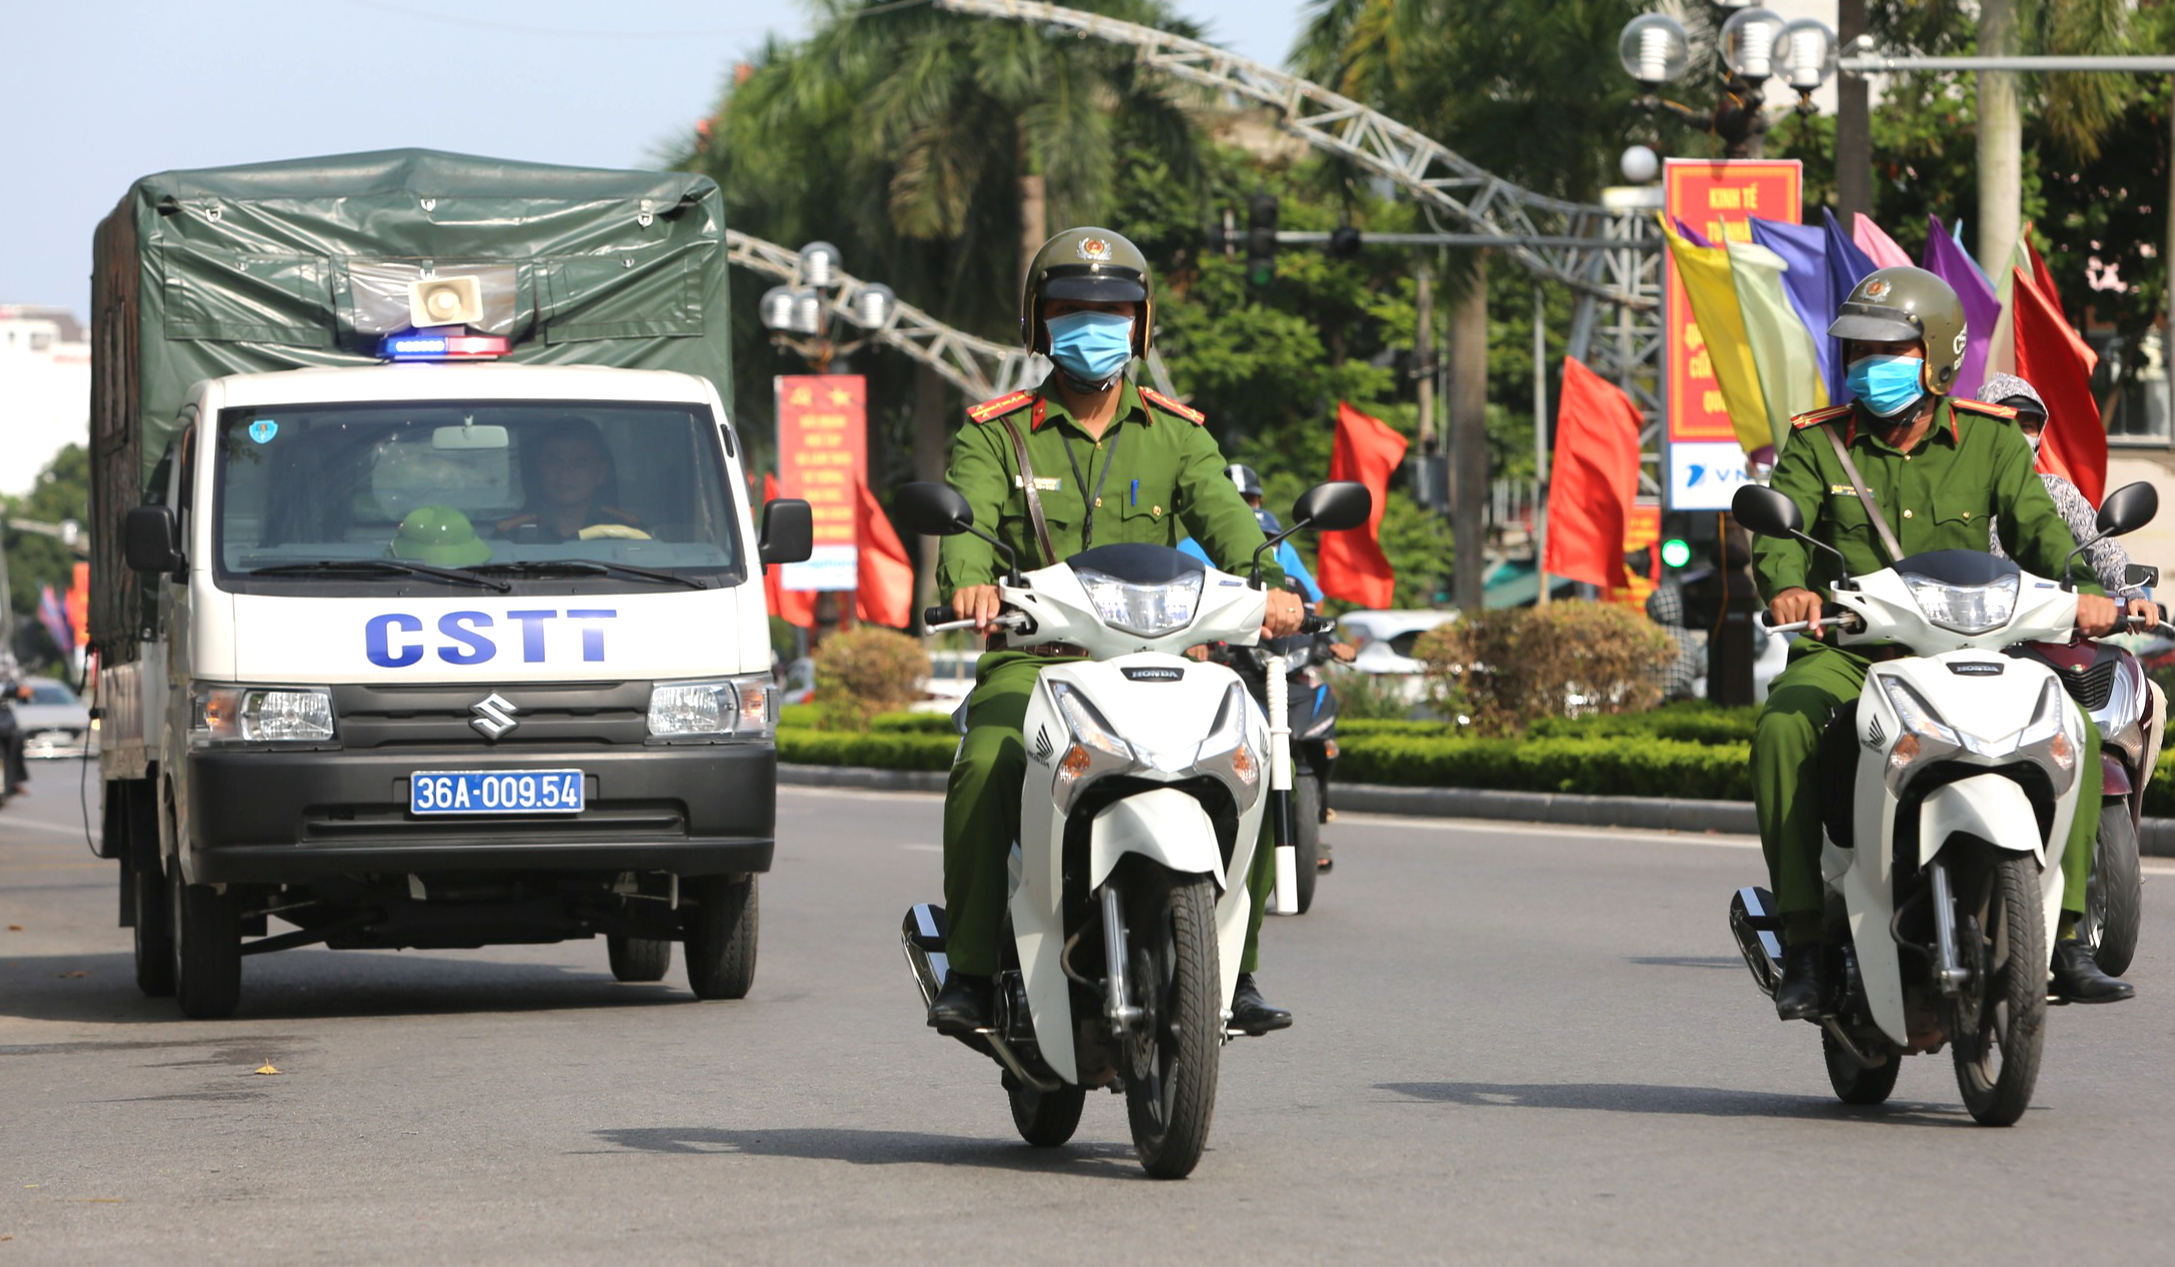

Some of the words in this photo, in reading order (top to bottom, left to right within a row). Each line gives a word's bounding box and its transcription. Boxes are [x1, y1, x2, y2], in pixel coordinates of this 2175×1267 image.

[1708, 187, 1741, 210] KINH
[365, 609, 617, 668] CSTT
[1131, 669, 1179, 678] HONDA
[417, 775, 578, 809] 36A-009.54
